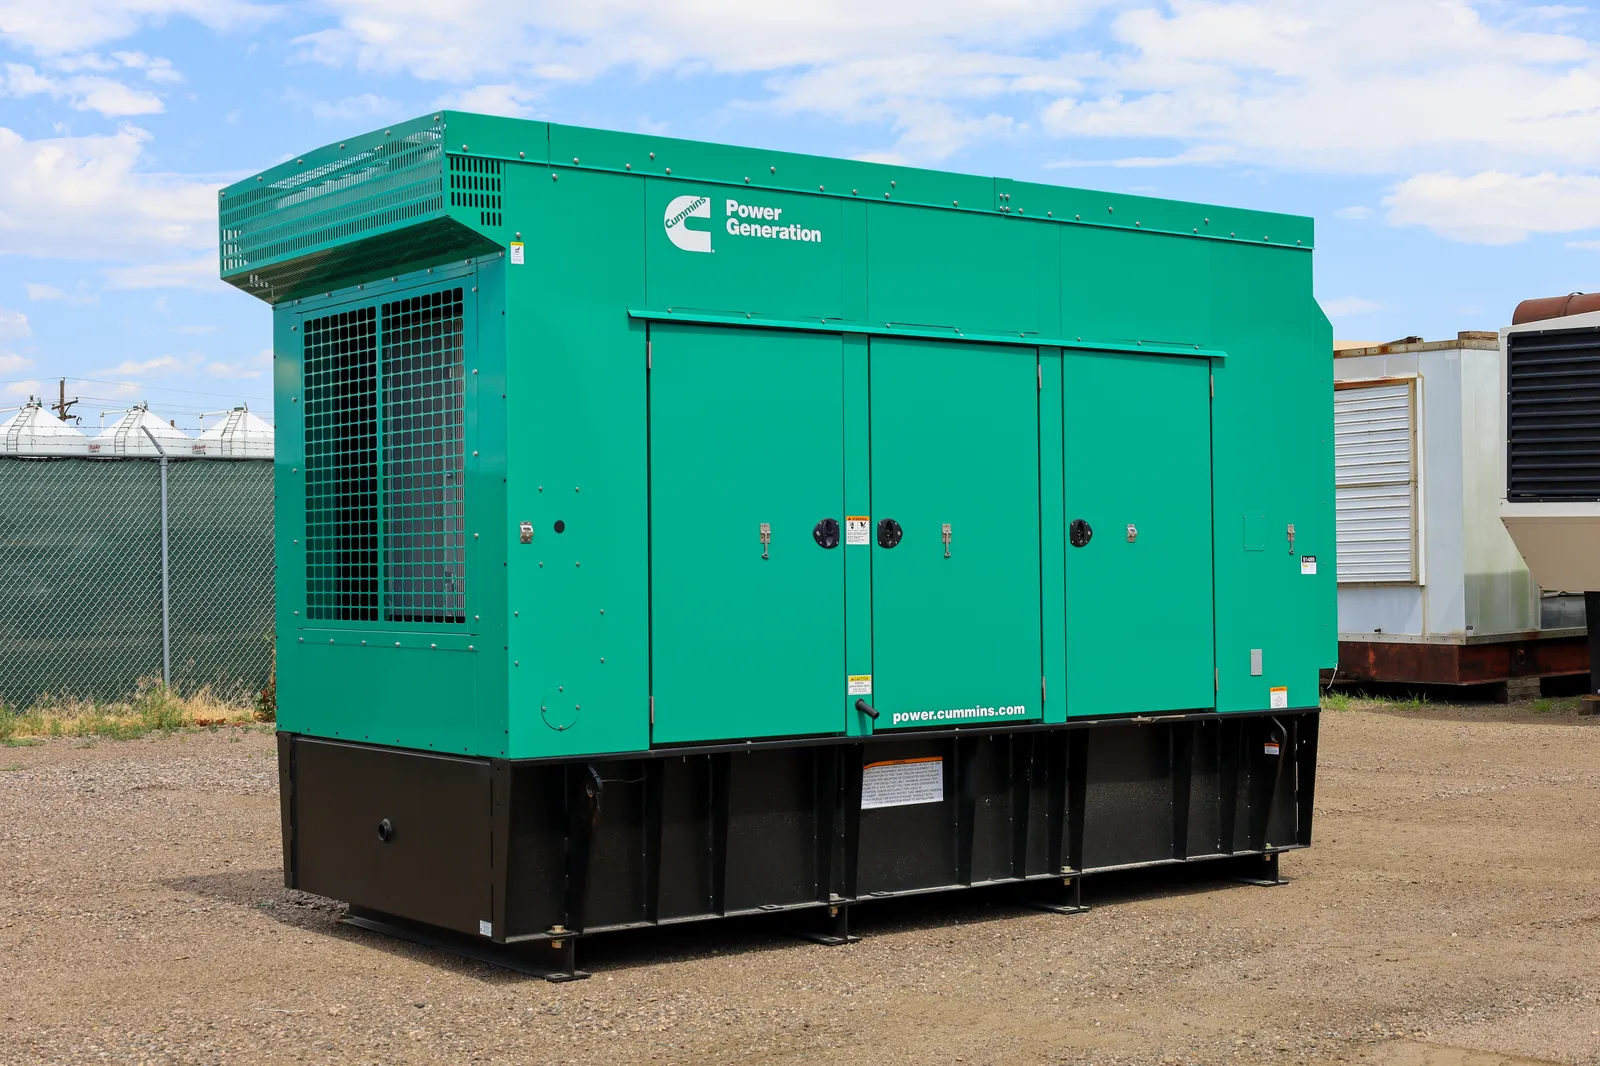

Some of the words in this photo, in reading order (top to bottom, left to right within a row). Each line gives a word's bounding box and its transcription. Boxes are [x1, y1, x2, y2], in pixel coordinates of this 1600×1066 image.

[665, 196, 706, 229] Cummins
[726, 199, 782, 221] Power
[726, 217, 822, 242] Generation
[893, 705, 1026, 725] power.cummins.com
